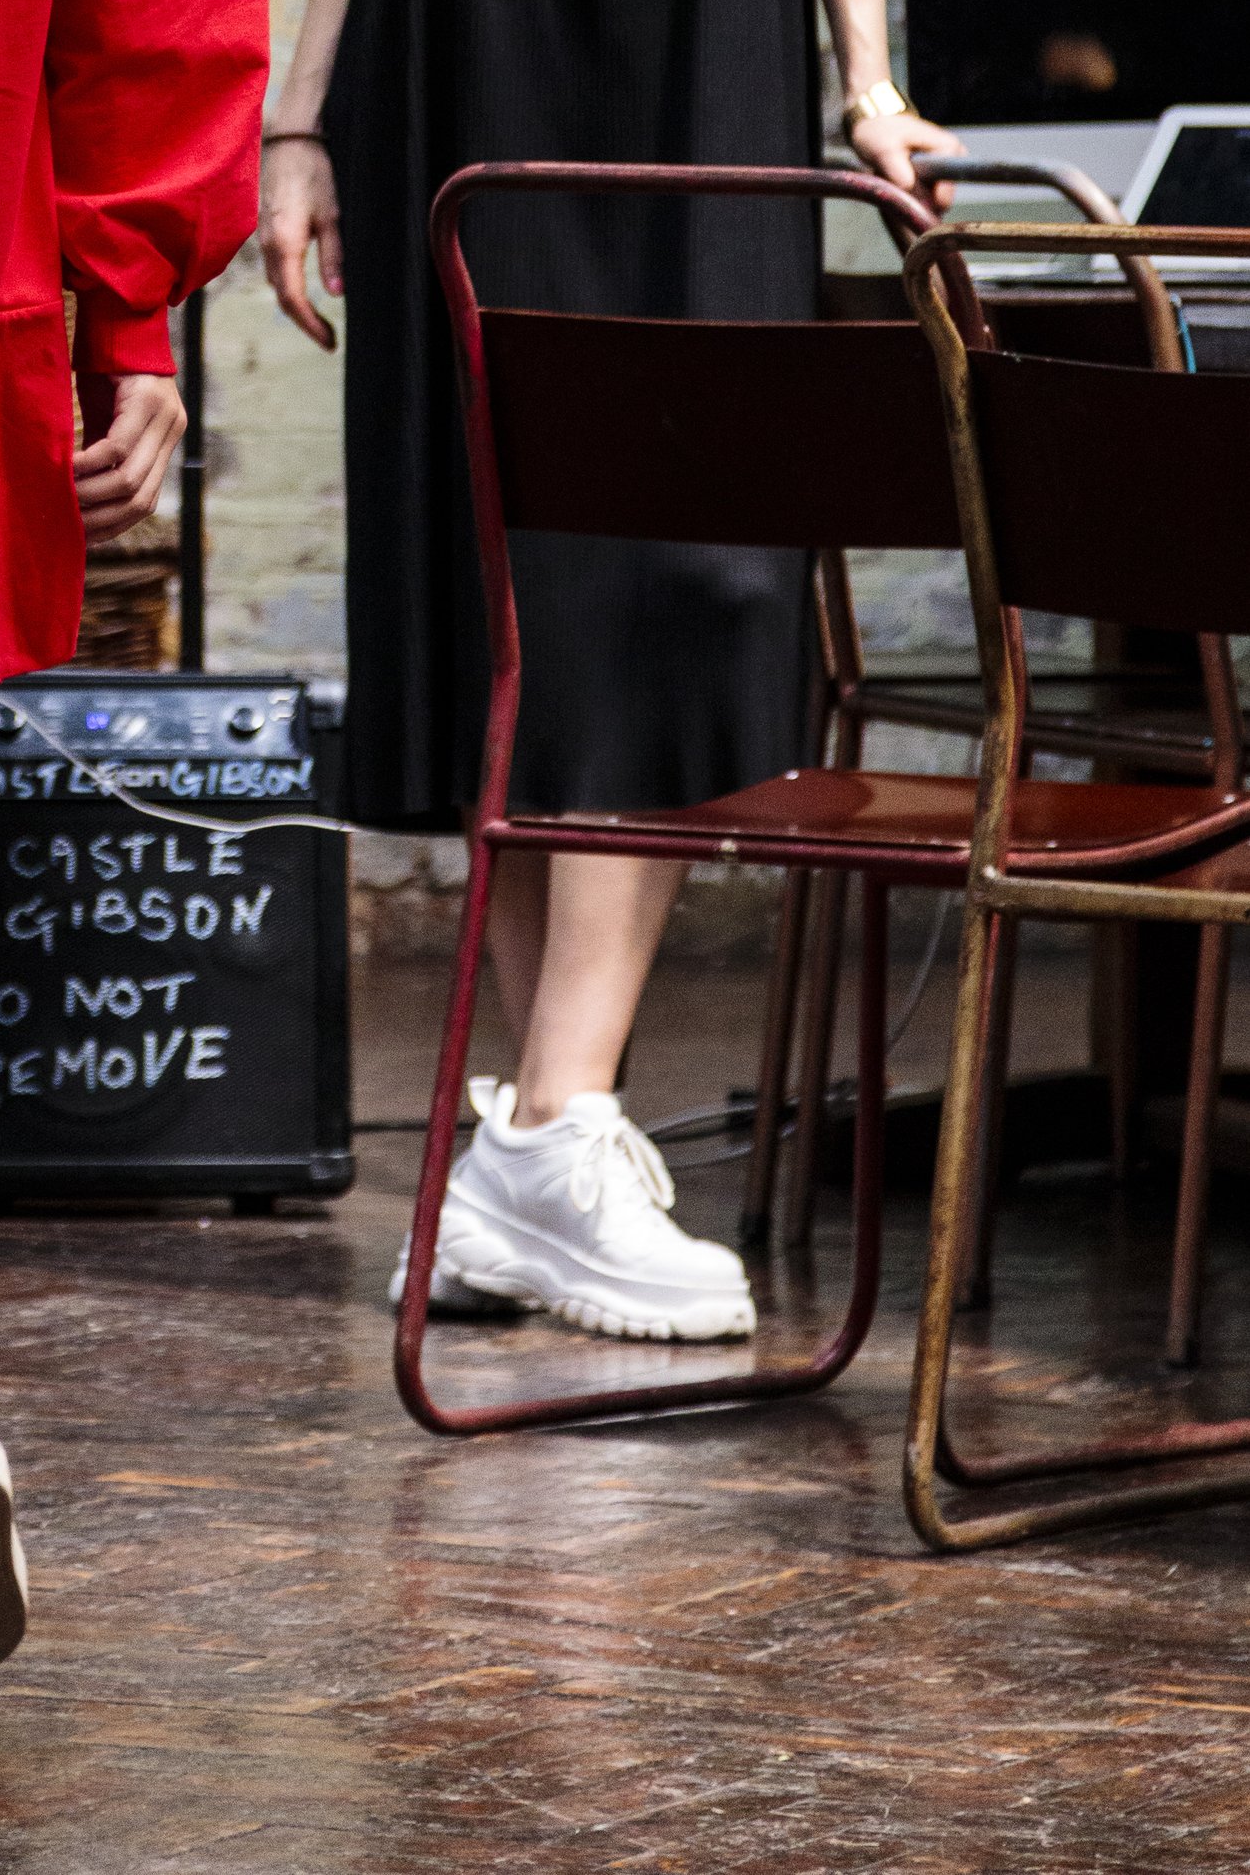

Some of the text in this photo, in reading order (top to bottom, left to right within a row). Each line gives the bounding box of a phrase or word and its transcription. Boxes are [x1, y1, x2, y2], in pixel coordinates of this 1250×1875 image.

[170, 755, 315, 798] GIBSON
[7, 831, 249, 883] CASTLE
[5, 884, 273, 955] GIBSON
[63, 971, 198, 1019] NOT
